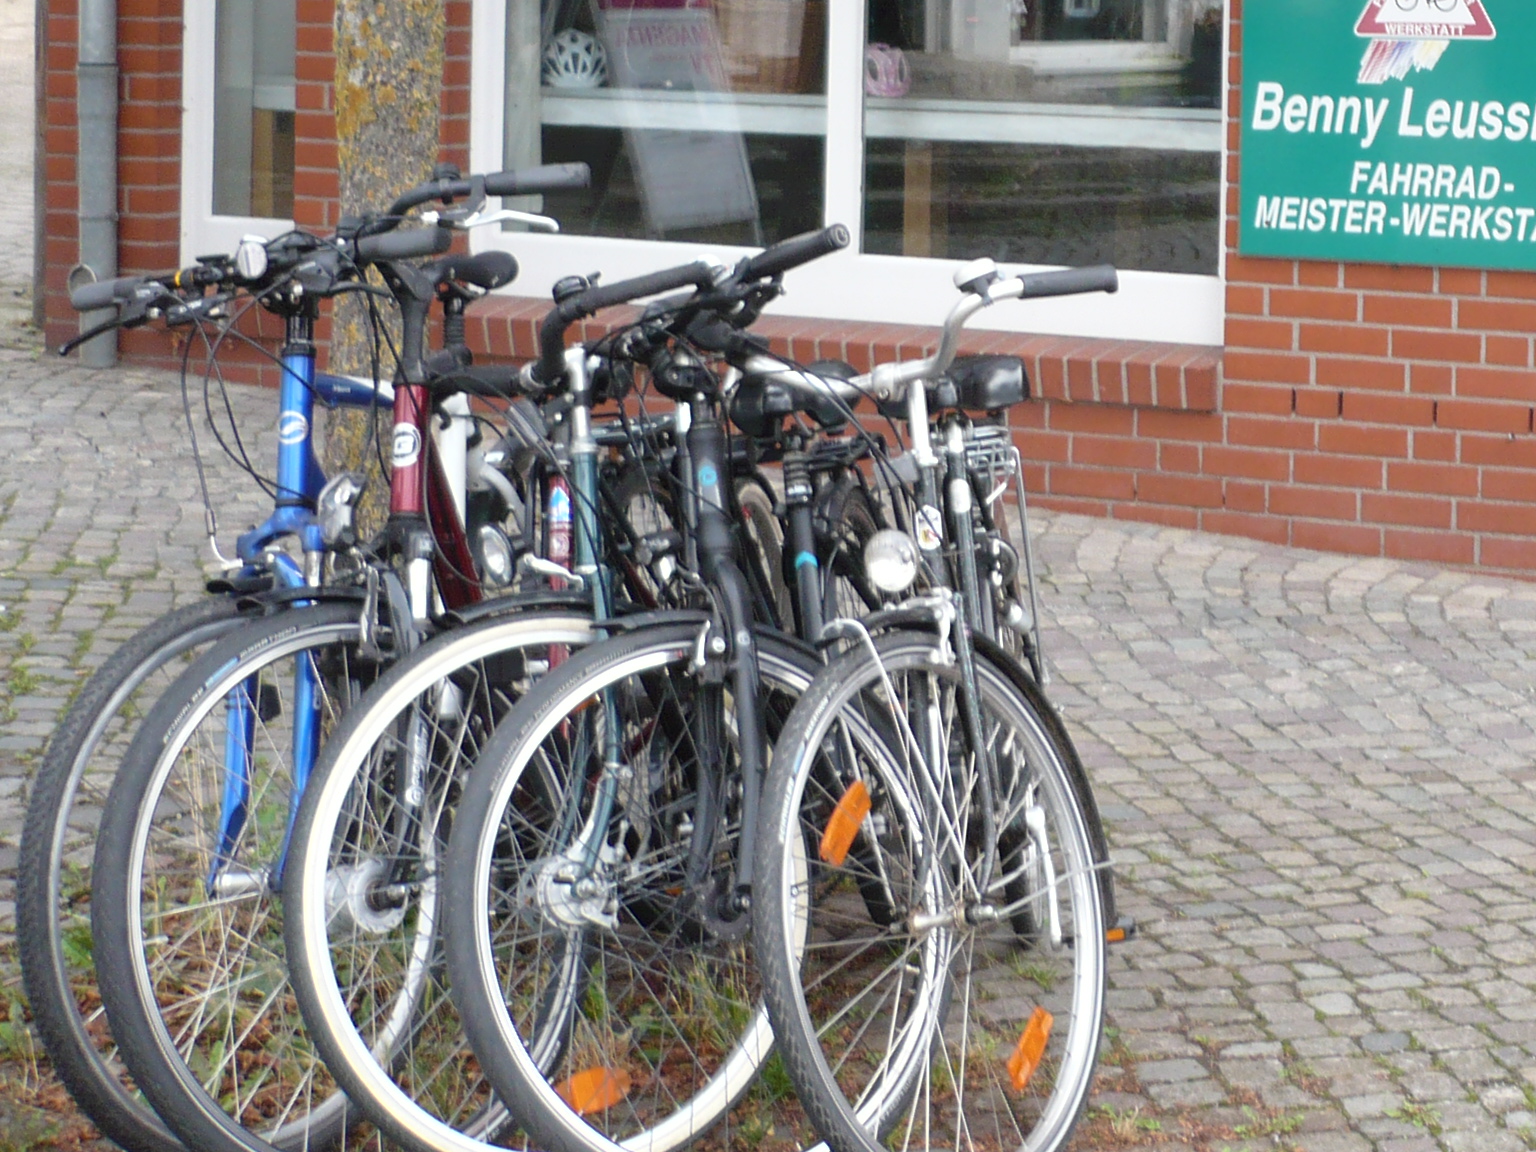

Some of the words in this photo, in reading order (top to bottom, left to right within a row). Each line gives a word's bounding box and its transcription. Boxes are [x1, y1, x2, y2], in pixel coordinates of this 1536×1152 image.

[1384, 23, 1466, 36] WERKSTATT
[1251, 81, 1389, 148] Benny
[1350, 161, 1515, 200] FAHRRAD-
